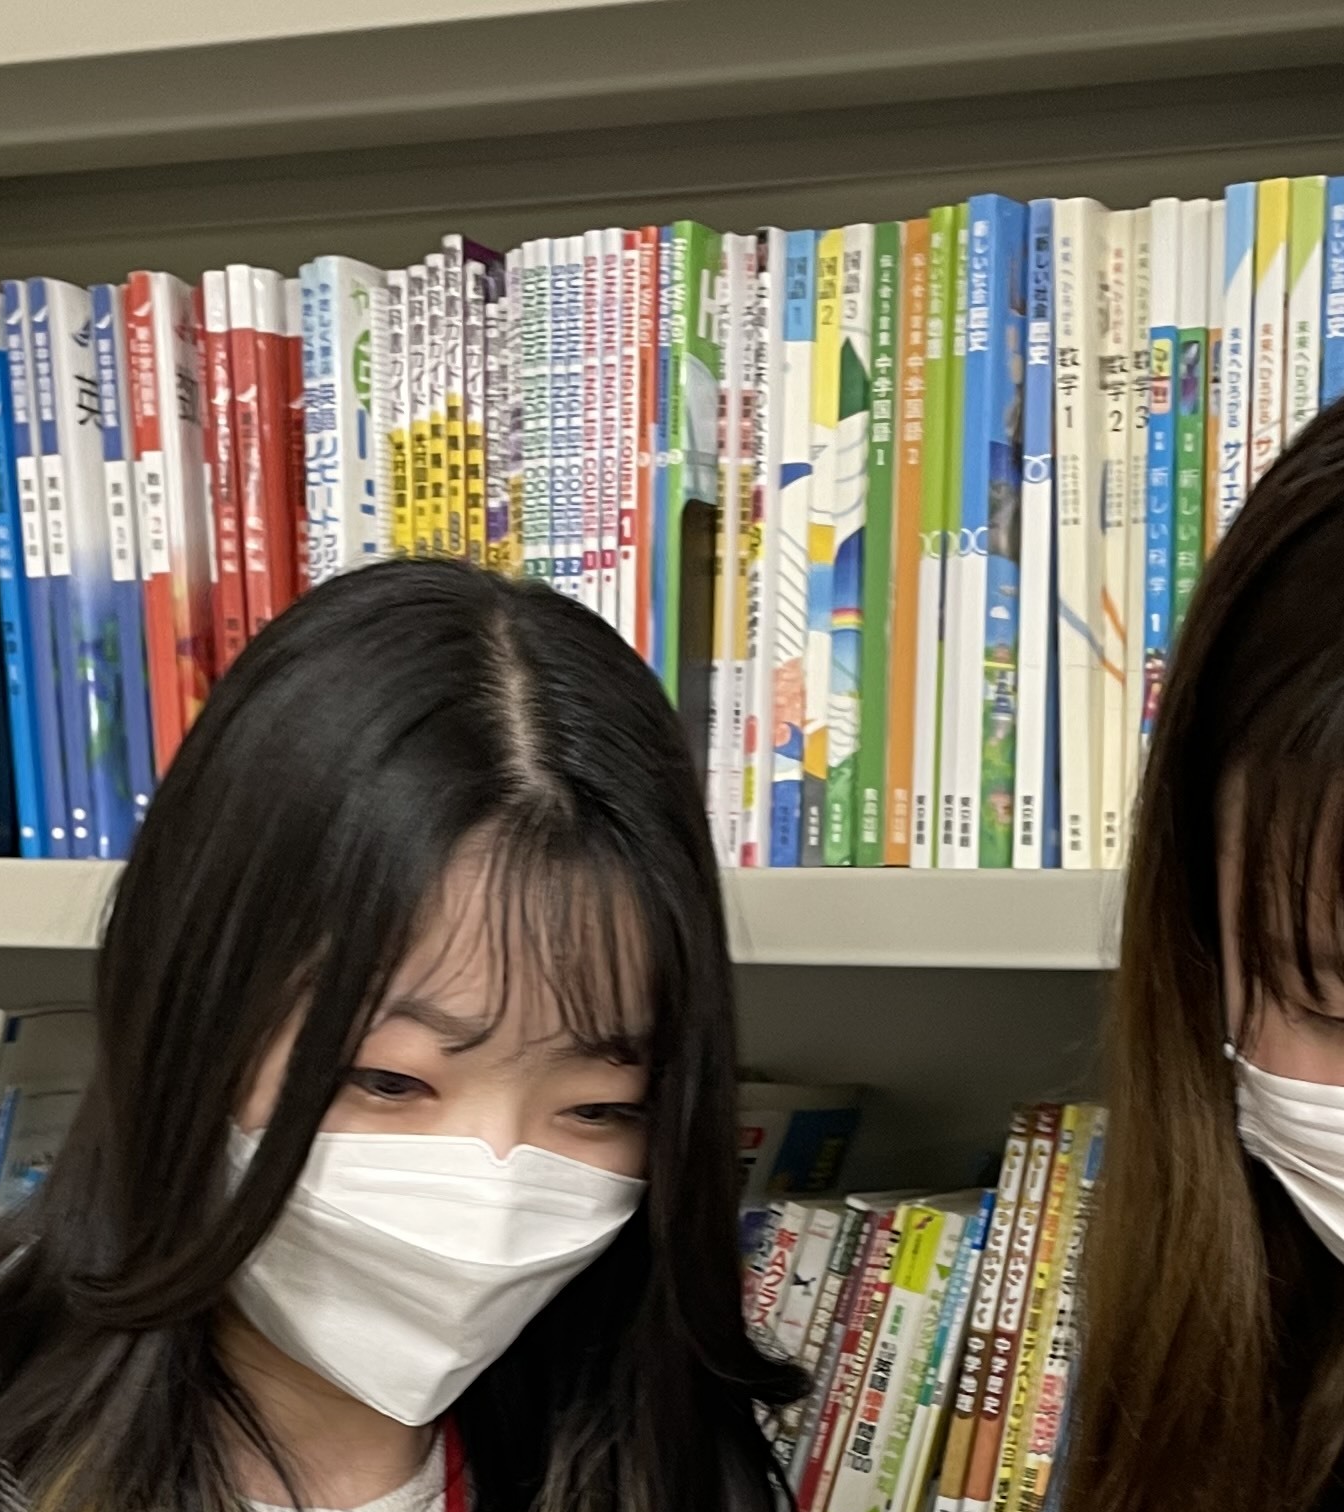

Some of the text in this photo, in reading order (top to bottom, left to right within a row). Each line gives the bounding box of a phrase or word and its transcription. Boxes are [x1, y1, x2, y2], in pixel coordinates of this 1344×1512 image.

[818, 256, 838, 325] 国語 2
[973, 220, 990, 305] 新しい社会
[1034, 233, 1049, 318] 新しい社会
[621, 258, 635, 347] SUNSHINE
[845, 299, 857, 319] 3
[969, 306, 990, 352] 歴史
[1028, 321, 1051, 366] 歴史
[1057, 347, 1080, 396] 数学
[1109, 354, 1130, 402] 数学
[1228, 328, 1243, 428] 未来へひろがる
[621, 355, 635, 428] ENGLISH
[873, 353, 893, 442] 中学国語
[904, 354, 925, 441] 中学国語
[1110, 410, 1122, 432] 2
[1136, 406, 1150, 429] 3
[621, 436, 635, 500] COURSE
[1149, 467, 1169, 596] 新しい科学
[1177, 469, 1200, 594] 新しい科学
